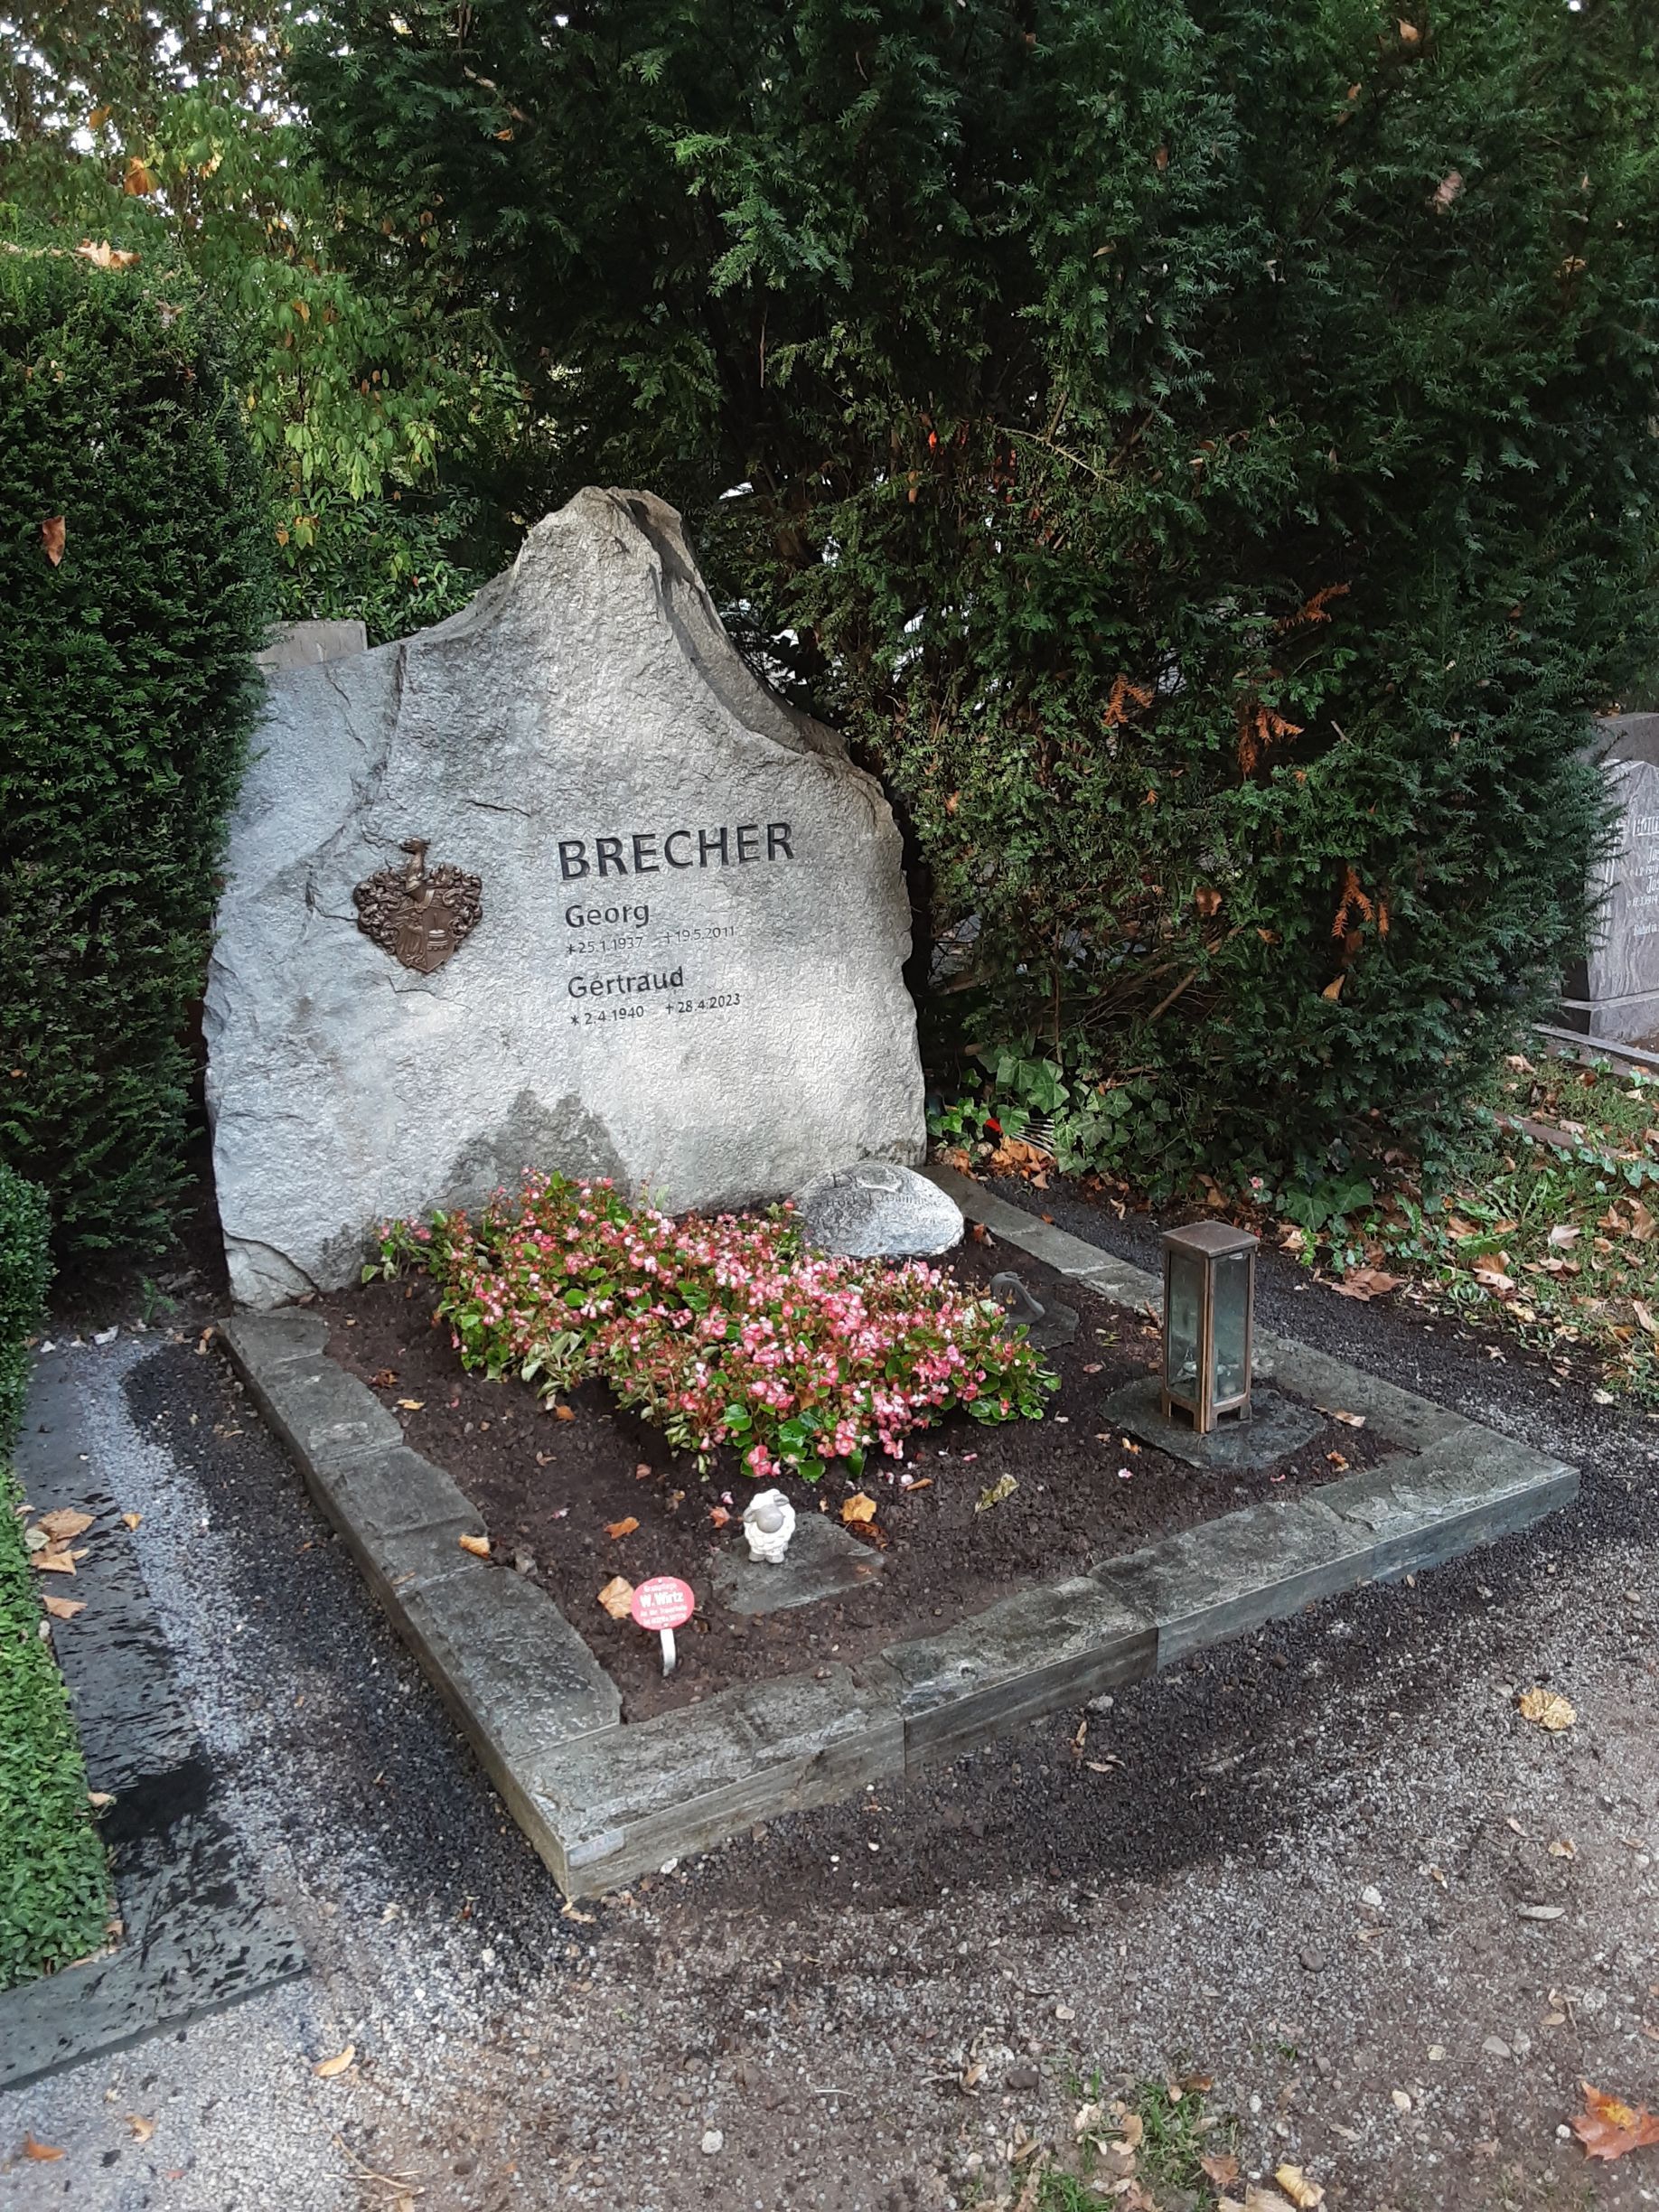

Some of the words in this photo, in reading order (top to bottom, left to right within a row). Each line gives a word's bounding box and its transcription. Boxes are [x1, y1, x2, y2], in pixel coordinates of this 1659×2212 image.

[558, 822, 795, 881] BRECHER
[565, 904, 650, 928] Georg
[567, 966, 684, 998] Gertraud
